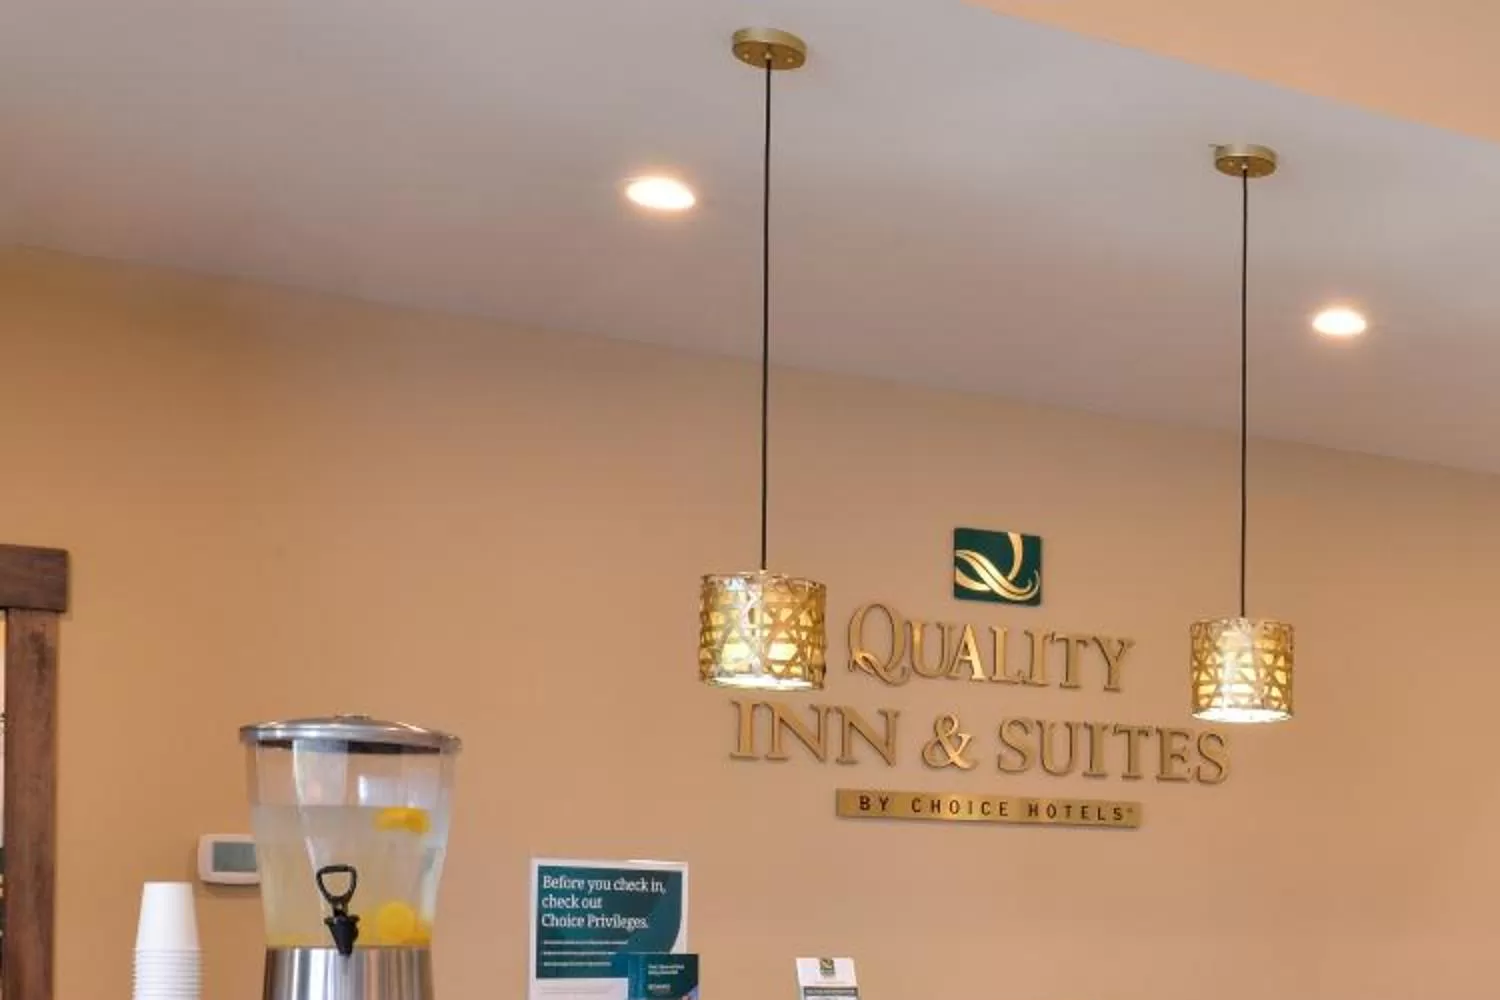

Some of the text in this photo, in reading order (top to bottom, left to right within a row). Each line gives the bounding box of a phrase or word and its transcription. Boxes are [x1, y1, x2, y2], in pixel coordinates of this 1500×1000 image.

[847, 603, 1134, 692] QUALITY
[730, 699, 1229, 784] INN & SUITES
[859, 795, 1123, 821] BY CHOICE HOTELS
[543, 875, 667, 894] Before you check in,
[541, 894, 602, 909] check out
[541, 913, 584, 928] Choice
